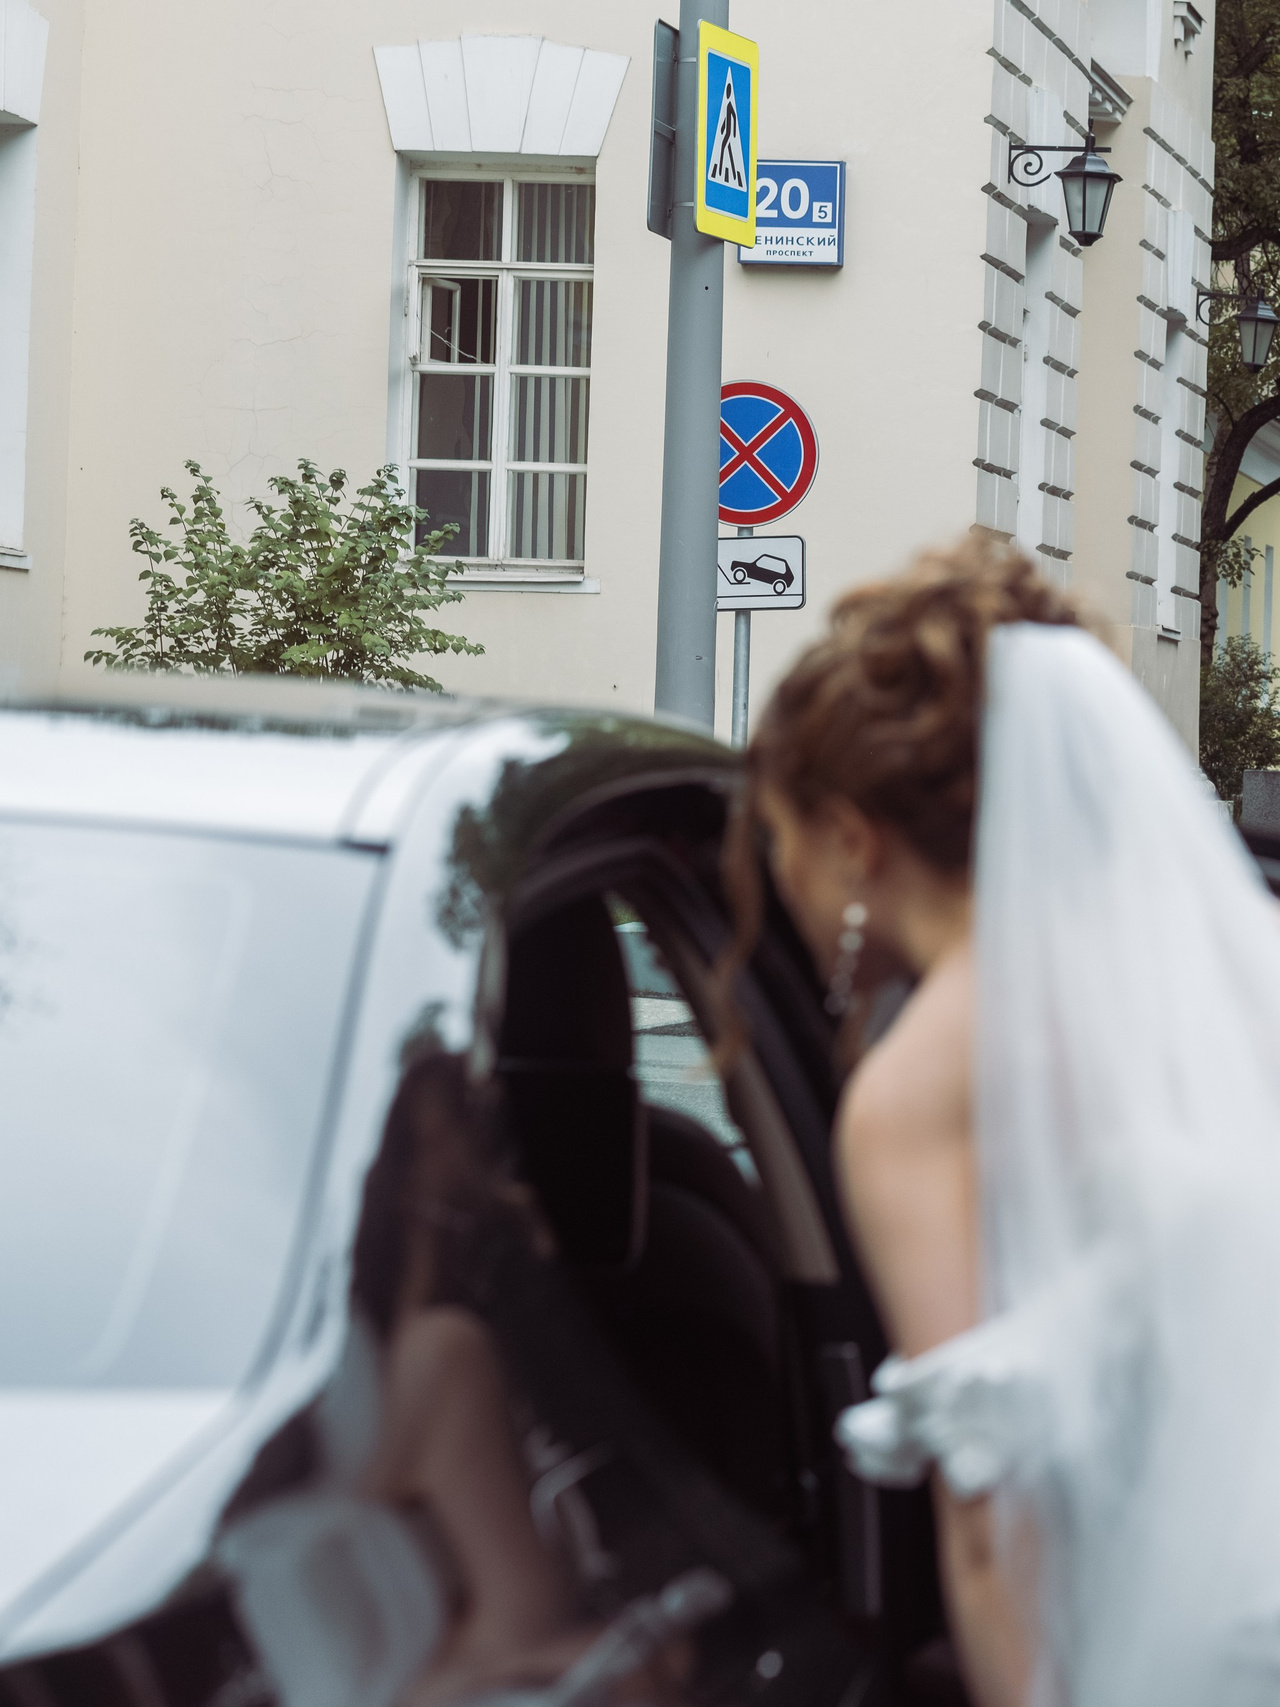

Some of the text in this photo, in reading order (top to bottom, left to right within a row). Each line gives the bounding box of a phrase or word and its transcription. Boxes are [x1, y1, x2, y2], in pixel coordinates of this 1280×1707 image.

[756, 177, 828, 219] 20 5
[755, 235, 836, 247] ЕНИНСКИЙ
